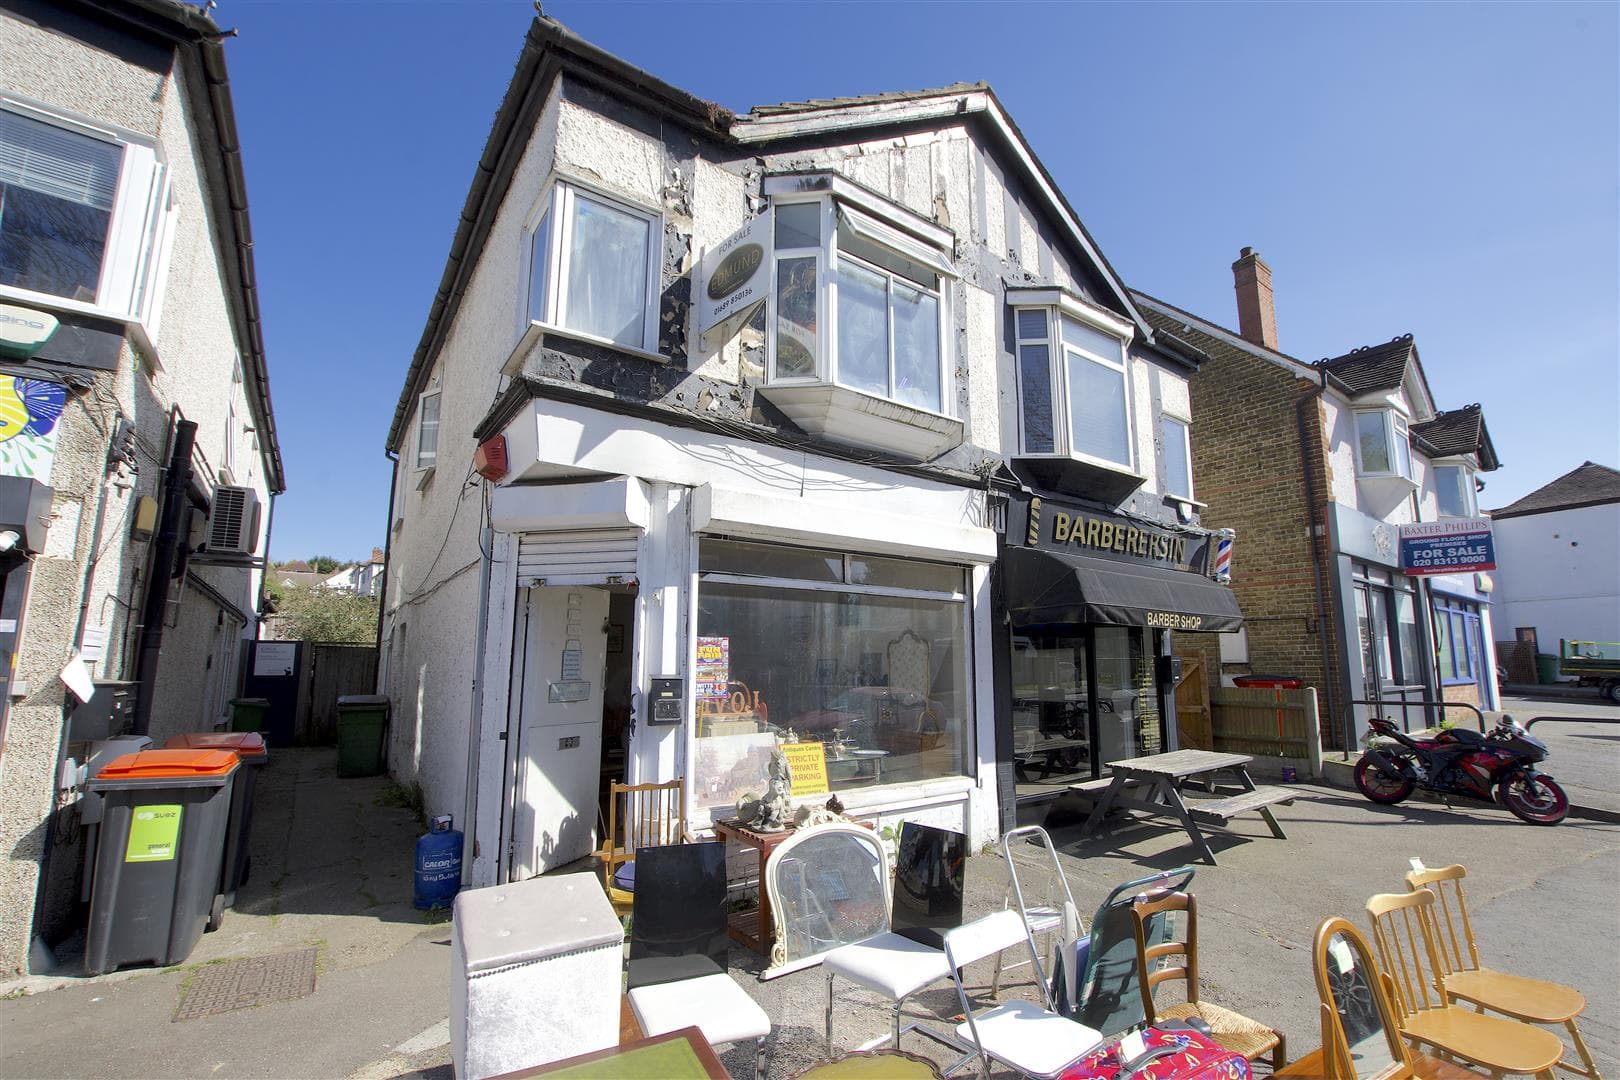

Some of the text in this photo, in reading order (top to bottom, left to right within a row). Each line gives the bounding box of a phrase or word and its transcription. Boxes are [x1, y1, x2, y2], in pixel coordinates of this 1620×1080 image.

[718, 226, 752, 256] FOR SALE
[711, 249, 760, 291] EDMUND
[1404, 521, 1488, 536] BAXTER PHILIPS
[1413, 545, 1487, 559] FOR SALE
[1413, 555, 1486, 567] 020 8313 9000
[1147, 612, 1201, 629] BARBER SHOP
[787, 754, 820, 763] STRICTLY
[424, 860, 450, 868] CALOR
